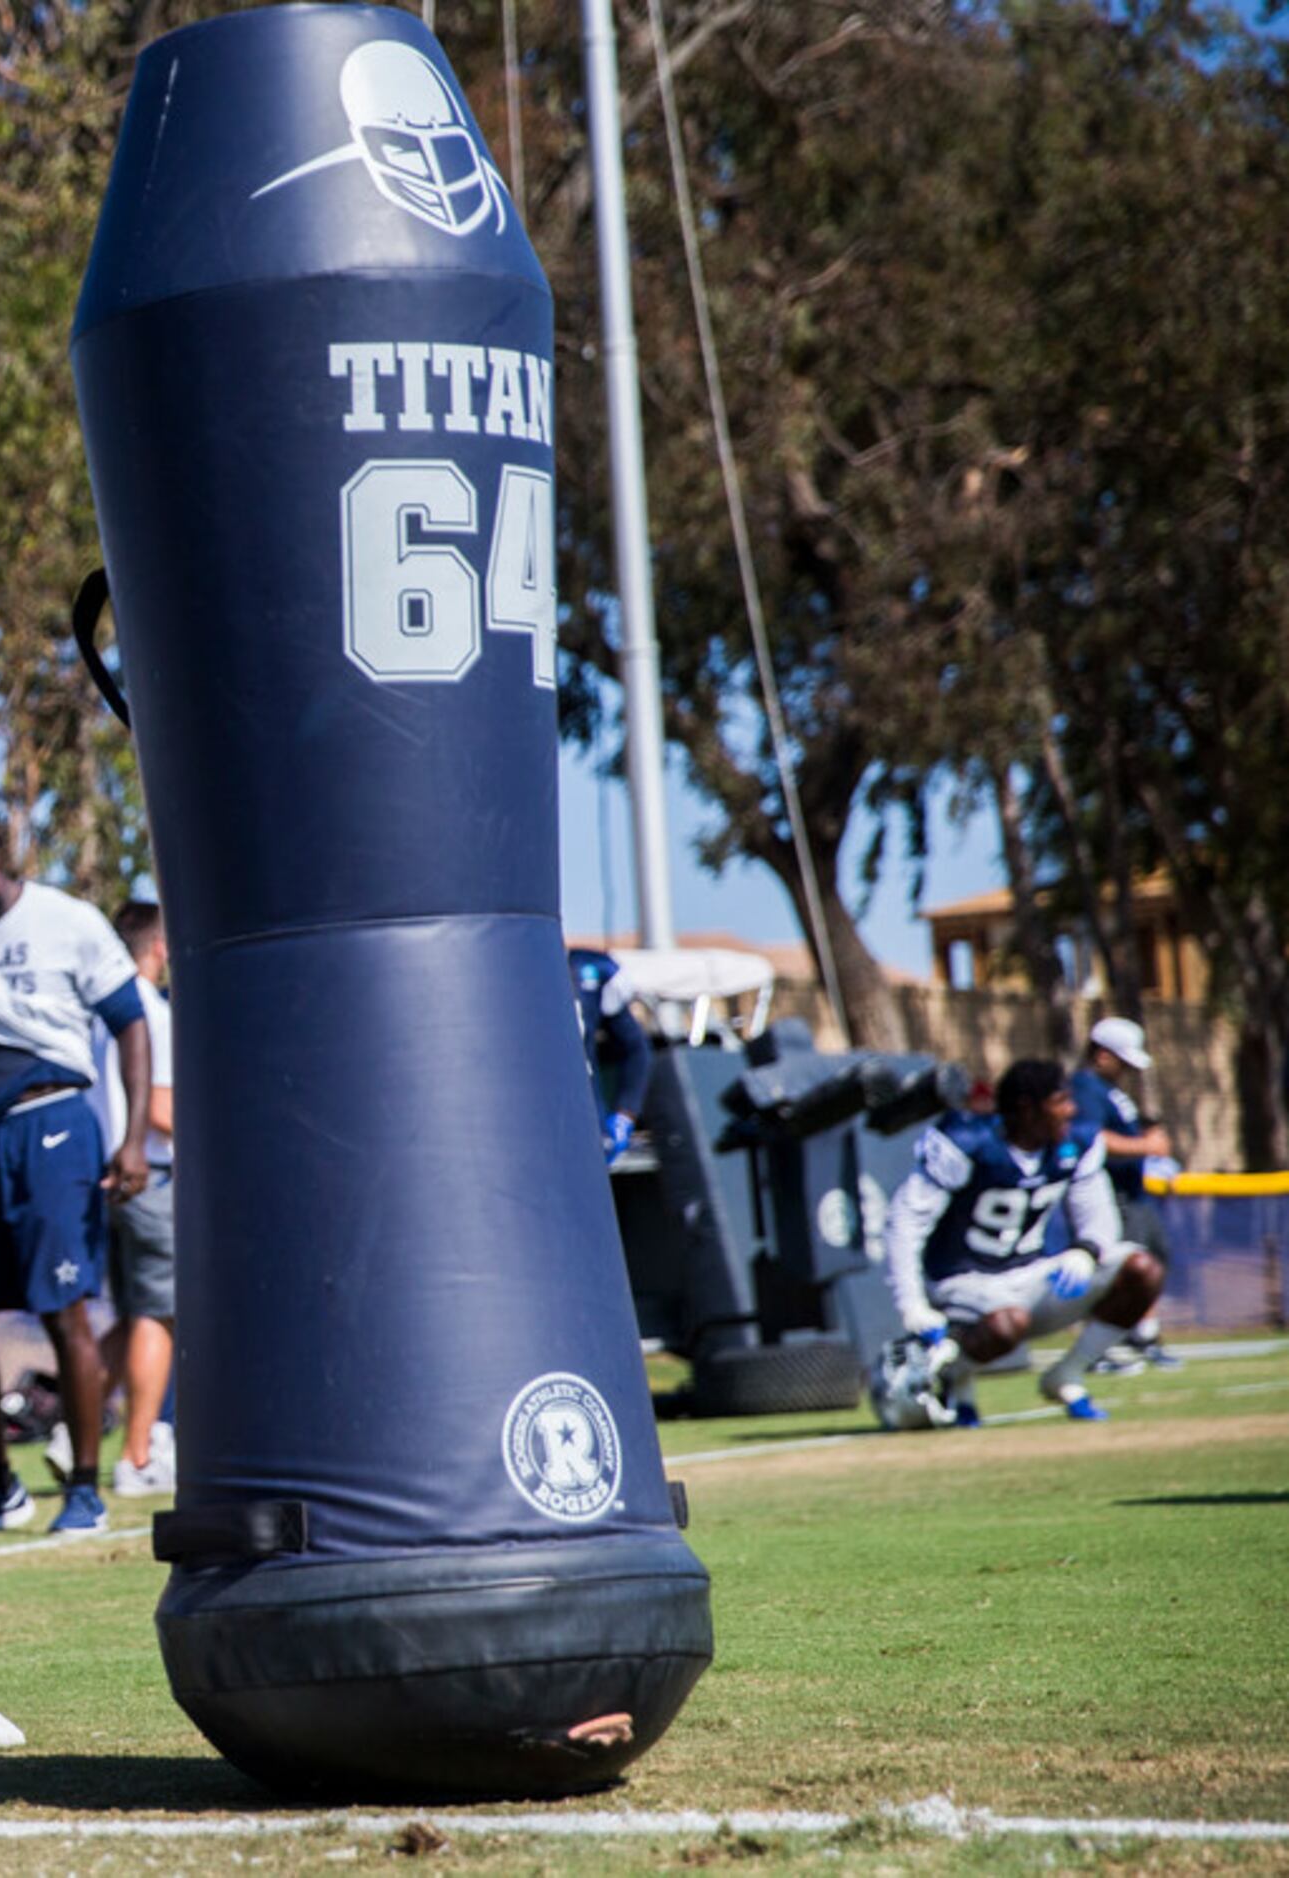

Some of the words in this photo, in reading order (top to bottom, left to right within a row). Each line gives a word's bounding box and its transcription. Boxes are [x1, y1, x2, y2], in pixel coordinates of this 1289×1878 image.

[328, 342, 555, 447] TITAN
[340, 458, 557, 690] 64
[964, 1179, 1070, 1258] 97
[534, 1478, 610, 1514] ROGERS
